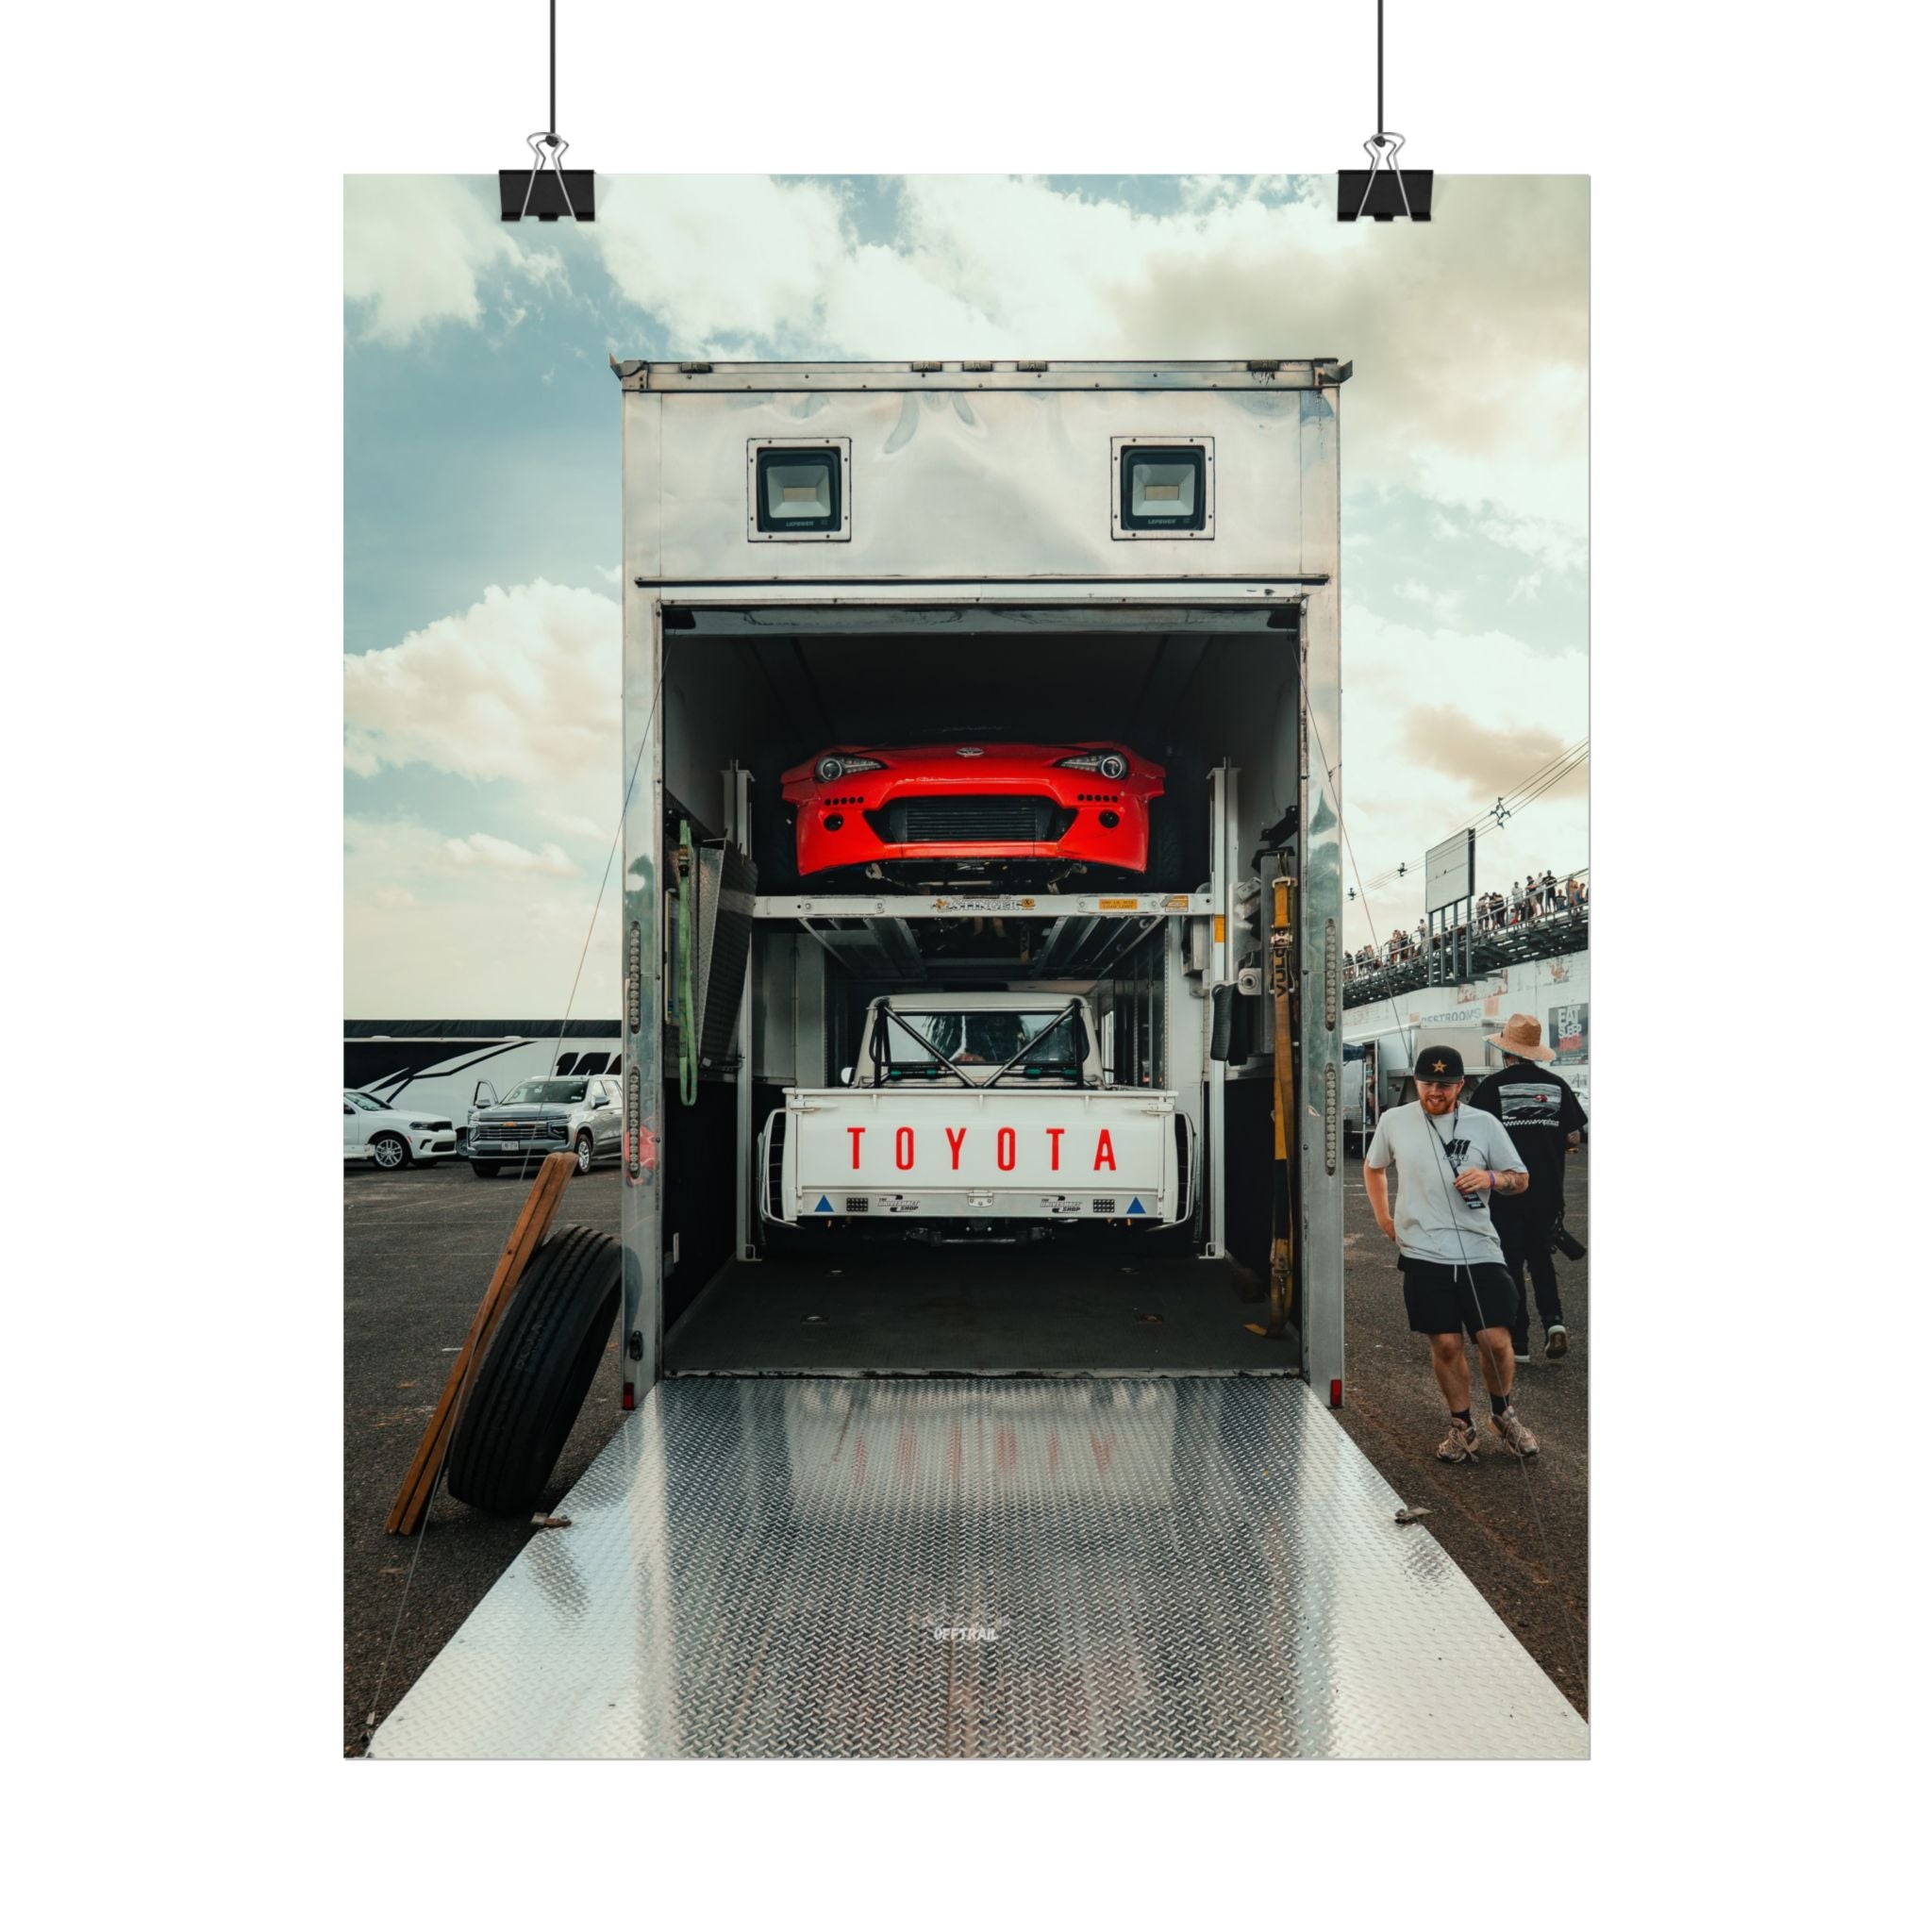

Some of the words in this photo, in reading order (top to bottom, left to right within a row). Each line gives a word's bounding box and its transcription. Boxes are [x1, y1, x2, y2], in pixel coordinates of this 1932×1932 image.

[1557, 1005, 1580, 1026] EAT
[1558, 1024, 1582, 1039] SLEEP
[847, 1126, 1117, 1172] TOYOTA
